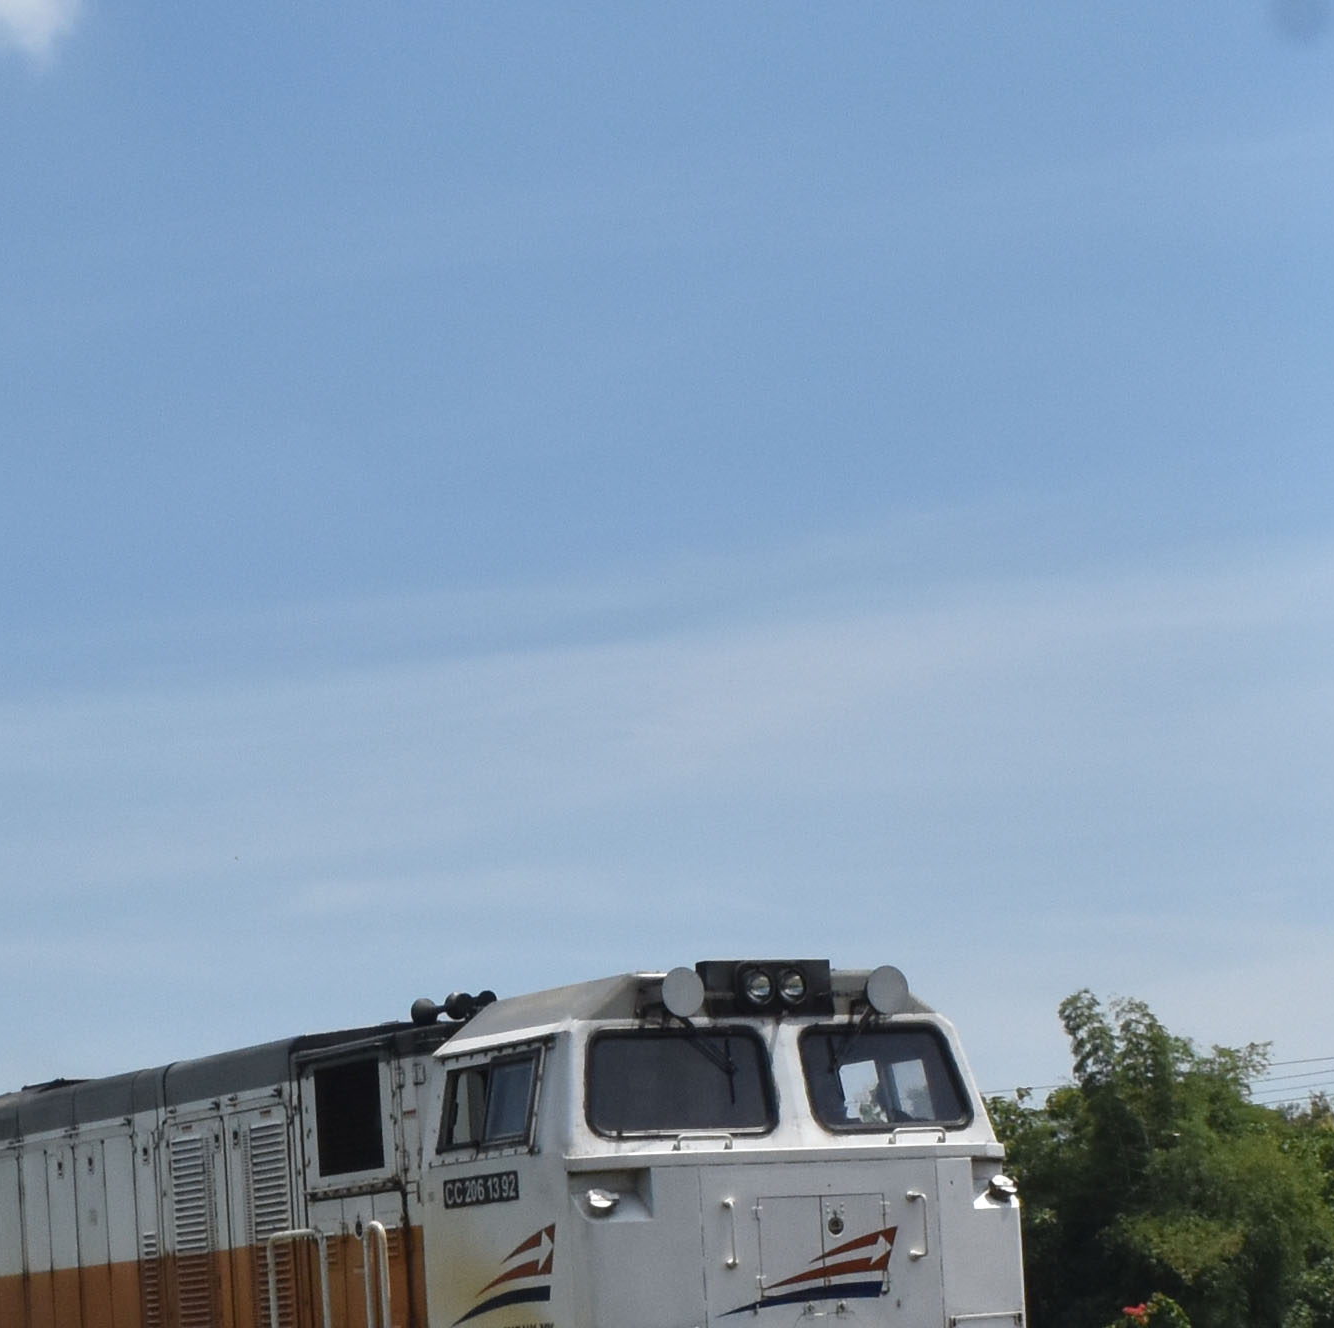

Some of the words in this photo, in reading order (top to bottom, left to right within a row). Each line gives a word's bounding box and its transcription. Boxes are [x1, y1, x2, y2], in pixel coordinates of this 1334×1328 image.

[445, 1181, 463, 1205] CC
[466, 1178, 485, 1201] 206
[487, 1176, 500, 1198] 13
[503, 1174, 517, 1197] 92
